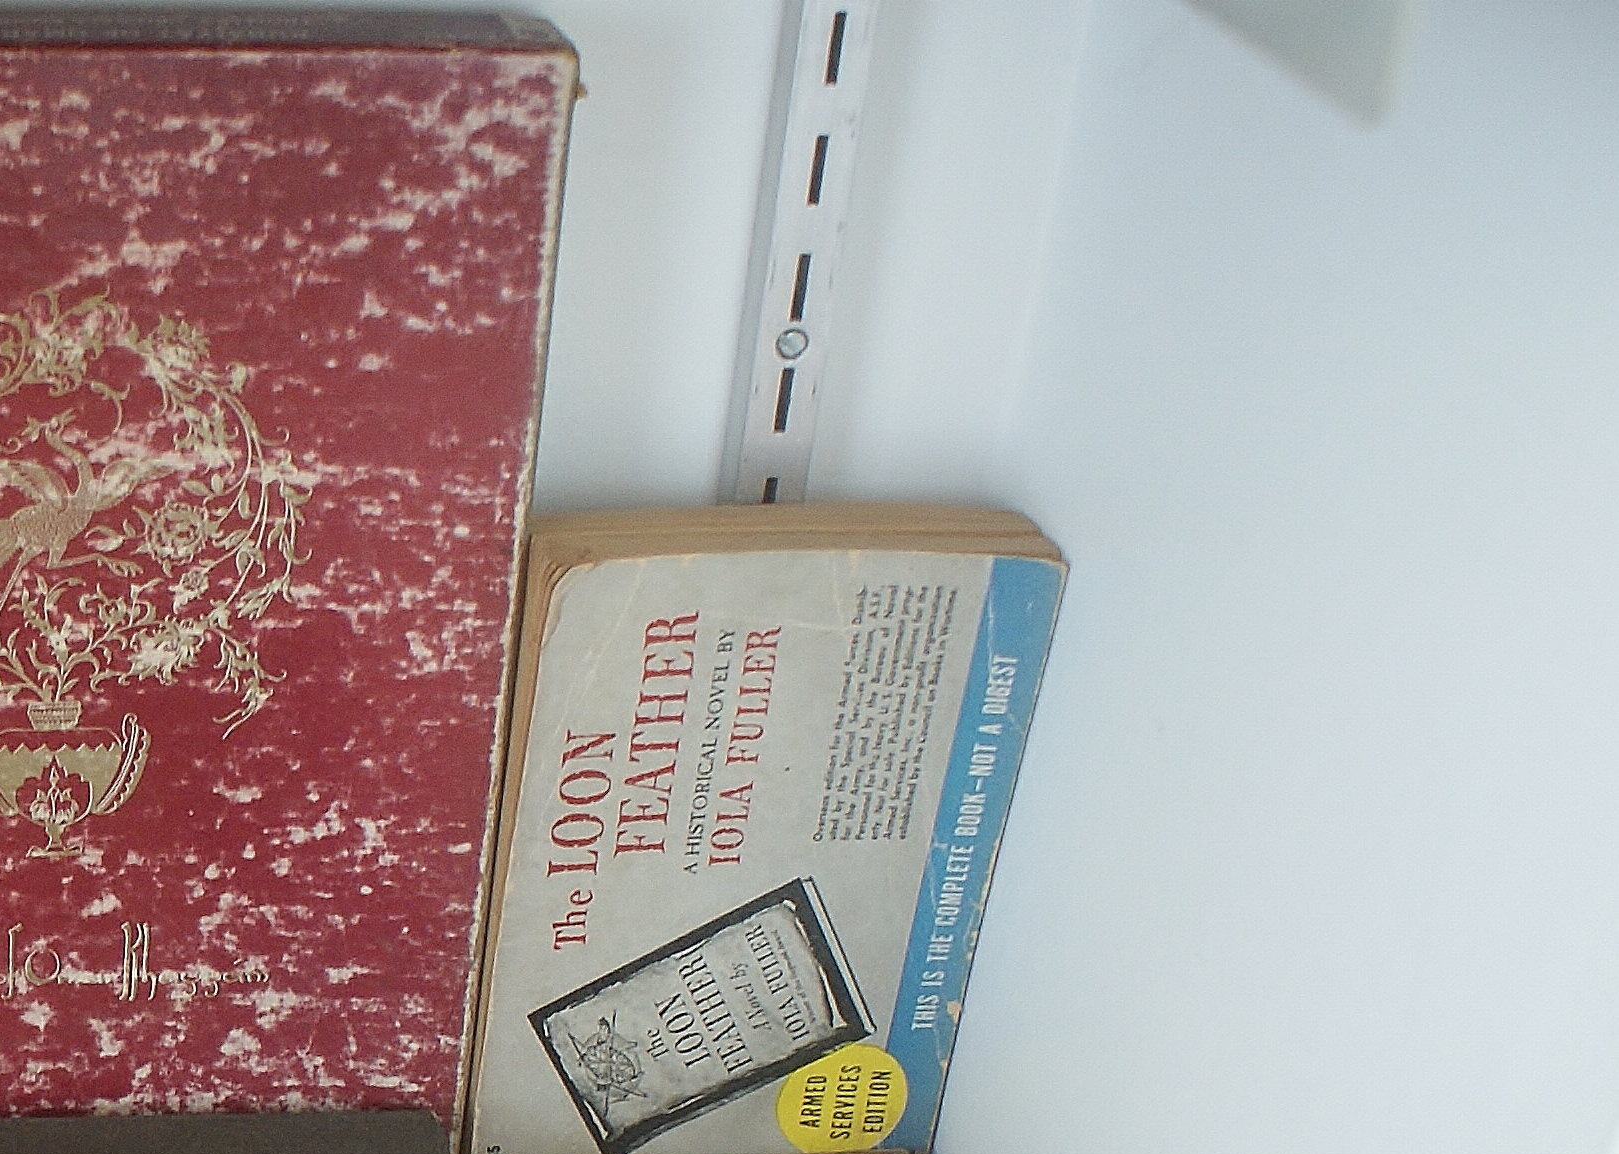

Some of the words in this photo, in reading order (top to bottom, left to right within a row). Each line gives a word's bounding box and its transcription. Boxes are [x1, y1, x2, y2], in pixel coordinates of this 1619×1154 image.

[717, 628, 736, 653] BY
[704, 659, 731, 730] NOVEL
[725, 625, 782, 765] FULLER
[982, 654, 1018, 715] DIGEST
[613, 609, 700, 858] FEATHER
[977, 723, 1003, 735] A
[546, 728, 617, 878] LOON
[685, 737, 718, 856] HISTORICAL
[708, 780, 754, 866] IOLA
[683, 862, 698, 875] A
[935, 845, 974, 926] COMPLETE
[552, 888, 594, 951] The
[927, 933, 954, 962] THE
[730, 962, 748, 980] by
[745, 923, 789, 995] FULLER
[921, 970, 945, 987] IS
[654, 992, 711, 1069] LOON
[678, 954, 753, 1074] FEATHER
[735, 982, 766, 1021] Novel
[778, 995, 810, 1041] IOLA
[911, 993, 940, 1031] THIS
[646, 1027, 670, 1061] The
[799, 1075, 828, 1128] ARMED
[829, 1065, 862, 1140] SERVICES
[862, 1070, 893, 1133] EDITION
